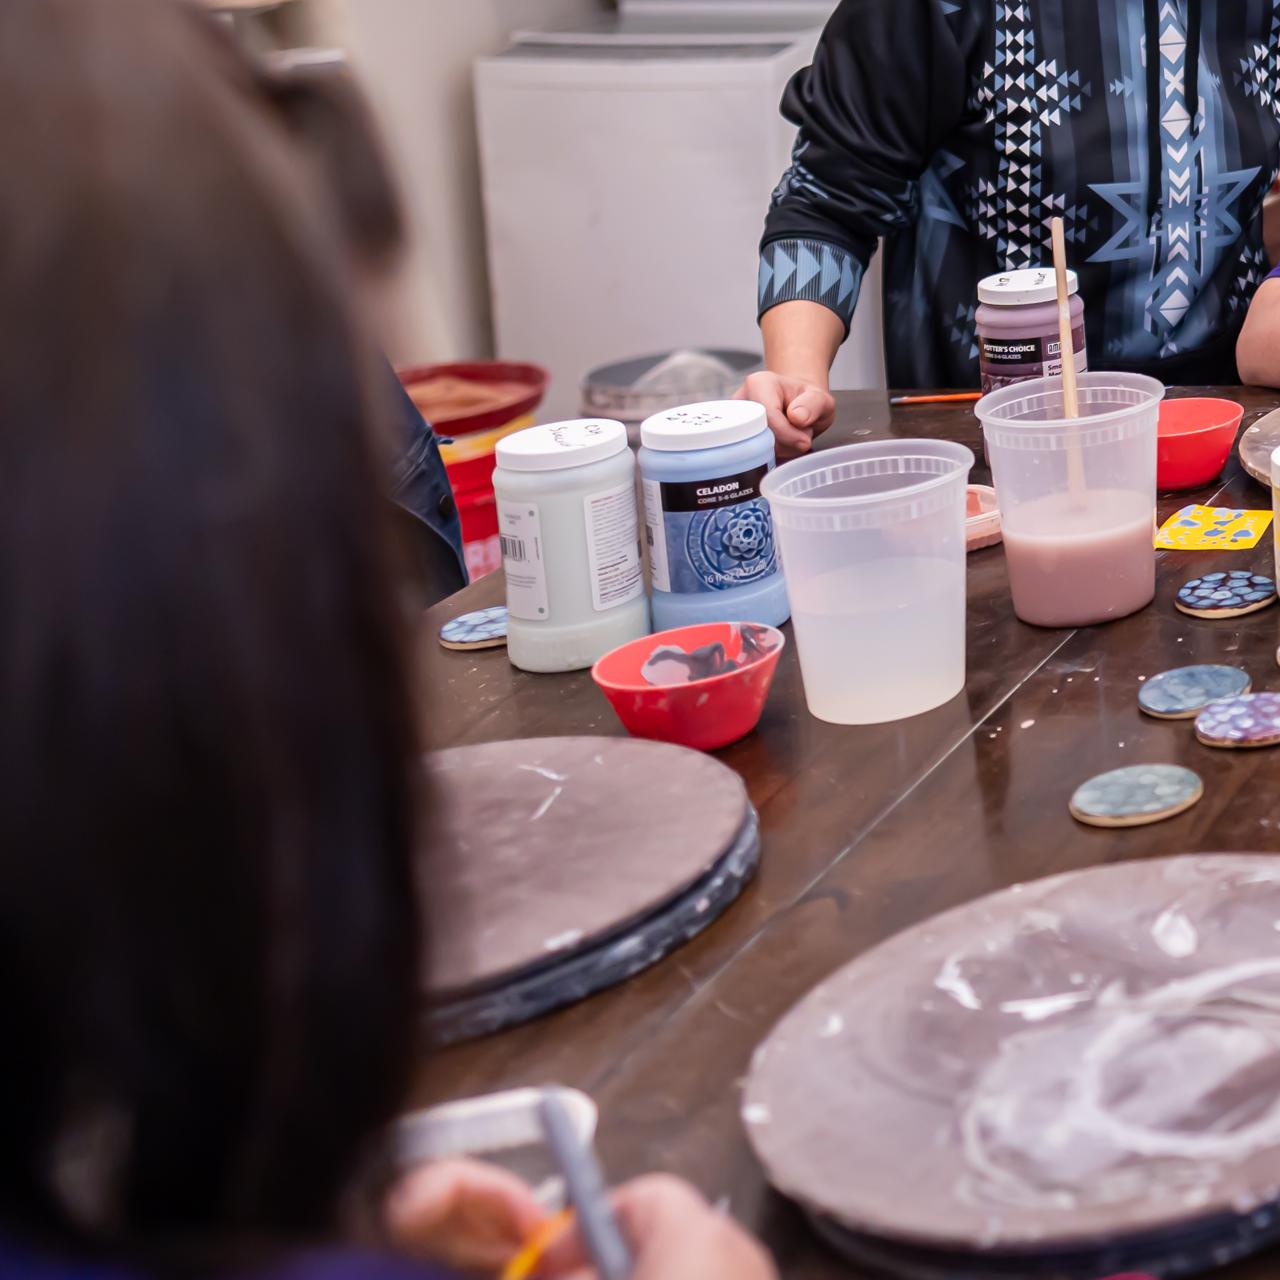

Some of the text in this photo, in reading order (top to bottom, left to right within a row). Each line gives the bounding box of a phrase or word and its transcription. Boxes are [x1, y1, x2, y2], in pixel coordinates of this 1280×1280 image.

[984, 344, 1035, 352] POTTER'S CHOICE
[696, 482, 739, 495] CELADON
[730, 488, 753, 498] GLAZES
[704, 574, 714, 584] 16
